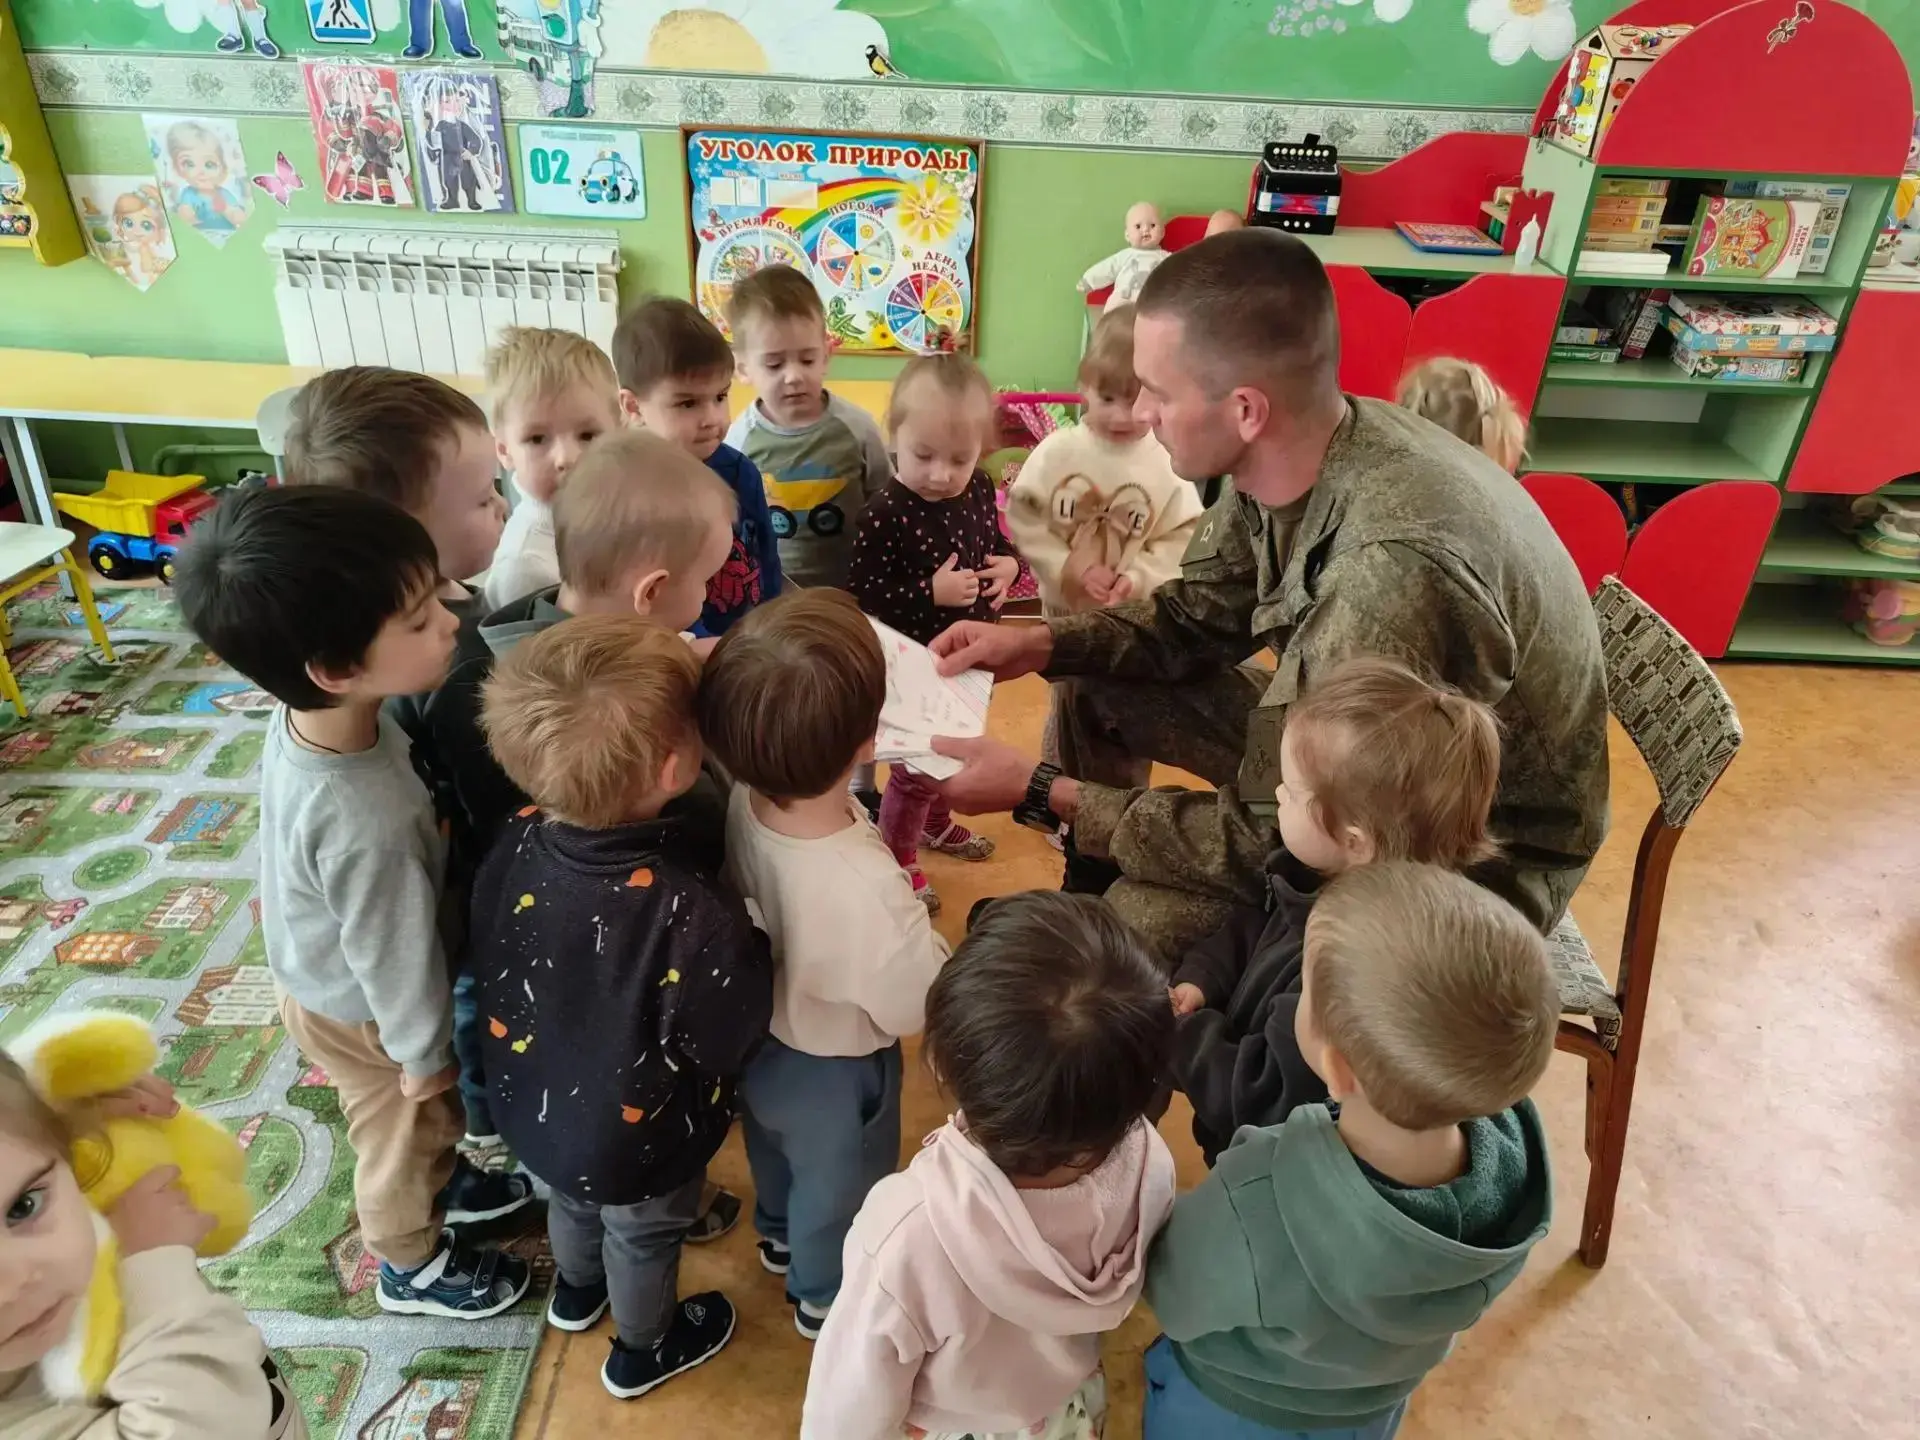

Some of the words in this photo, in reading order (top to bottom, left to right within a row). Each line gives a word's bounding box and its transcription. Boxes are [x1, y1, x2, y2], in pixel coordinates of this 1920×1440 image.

[530, 147, 571, 185] 02
[700, 140, 815, 164] УГОЛОК
[829, 145, 969, 170] ПРИРОДЫ
[829, 201, 884, 218] ПОГОДА
[719, 217, 761, 238] ВРЕМЯ
[768, 218, 801, 241] ГОДА
[924, 250, 958, 270] ДЕНЬ
